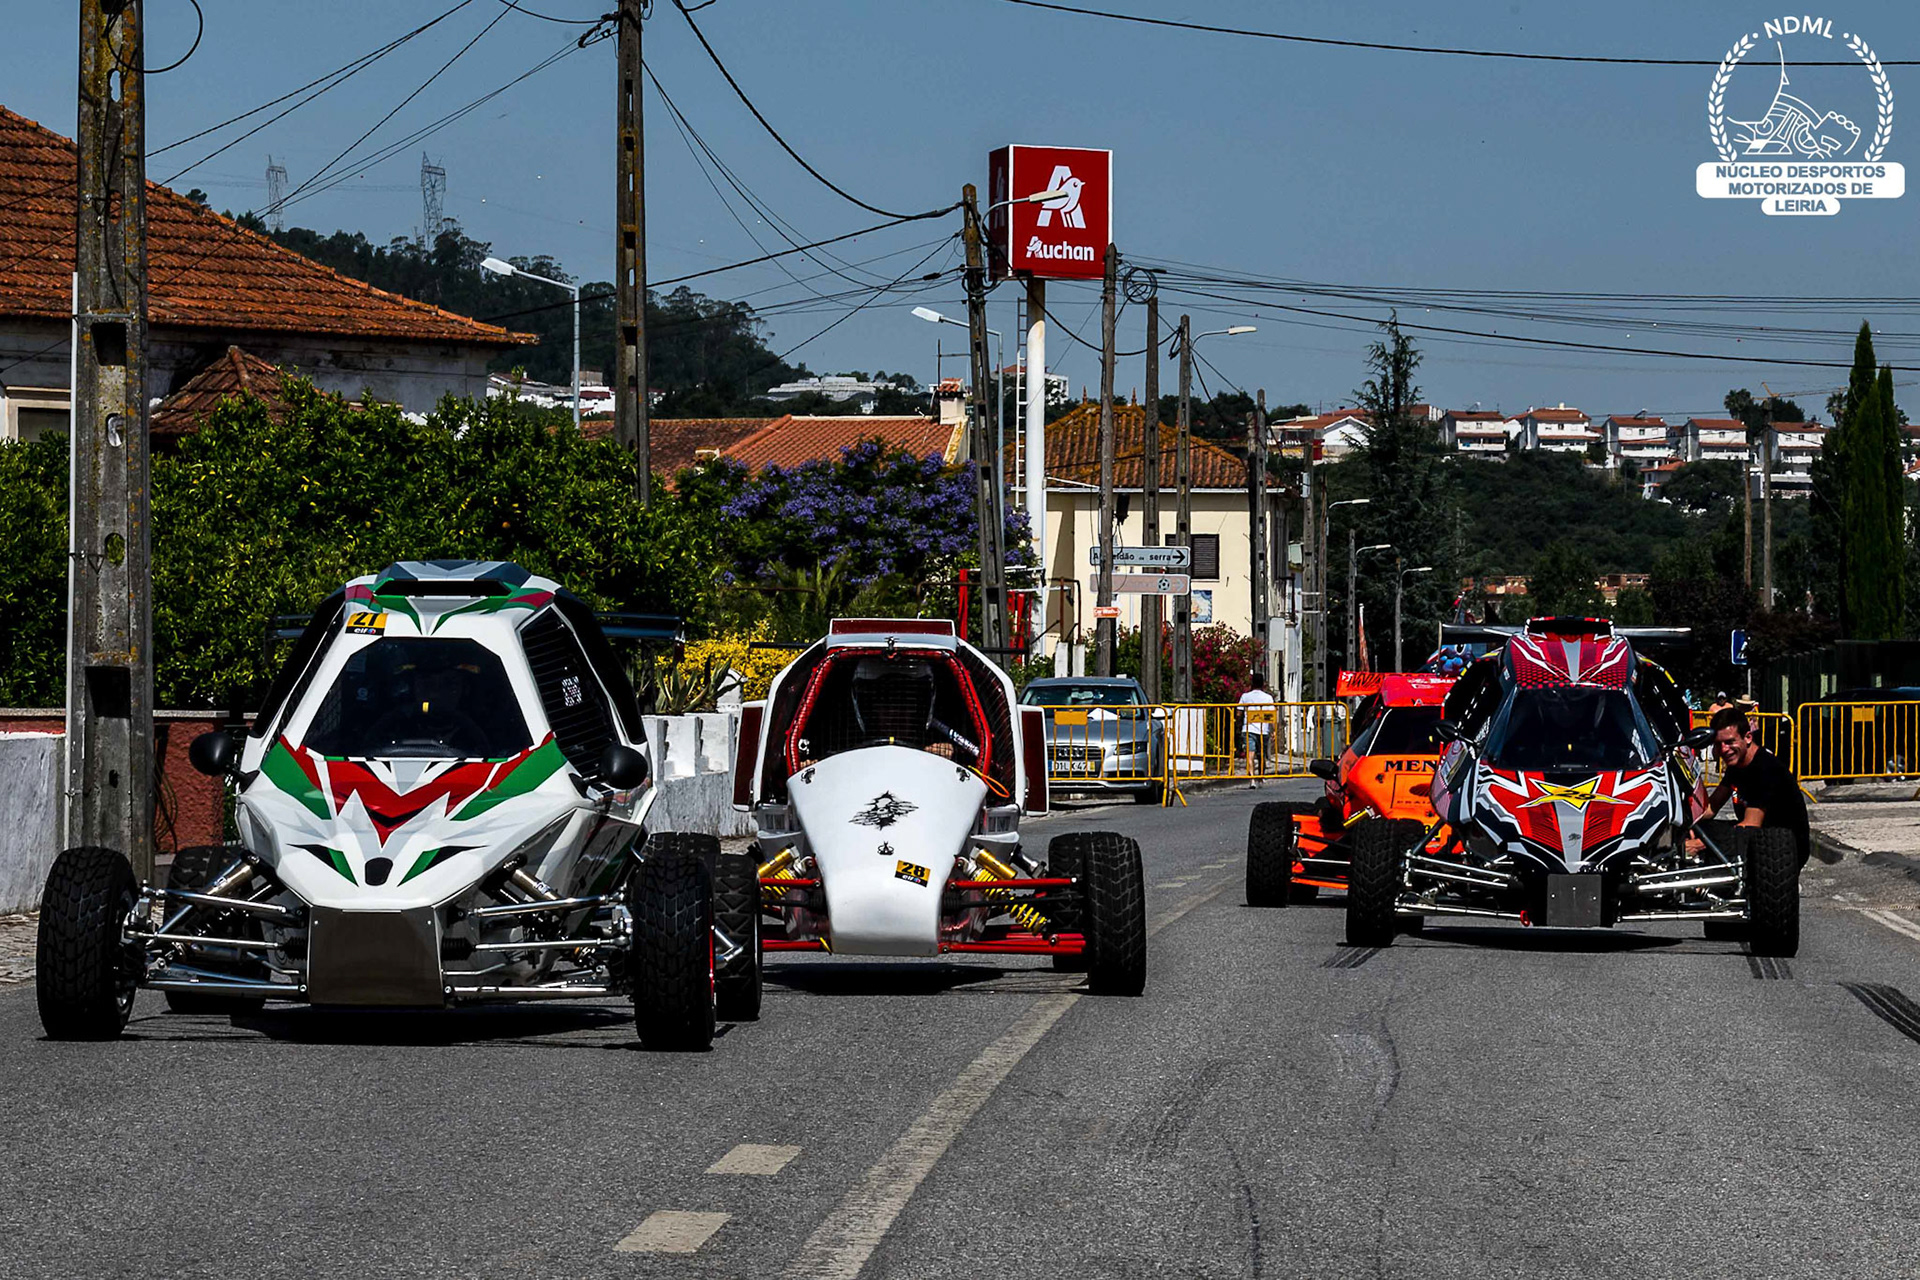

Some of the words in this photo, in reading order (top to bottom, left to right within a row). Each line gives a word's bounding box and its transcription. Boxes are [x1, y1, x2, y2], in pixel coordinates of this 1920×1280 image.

[1025, 235, 1095, 261] Auchan
[1149, 553, 1172, 561] serra
[901, 861, 926, 878] 28
